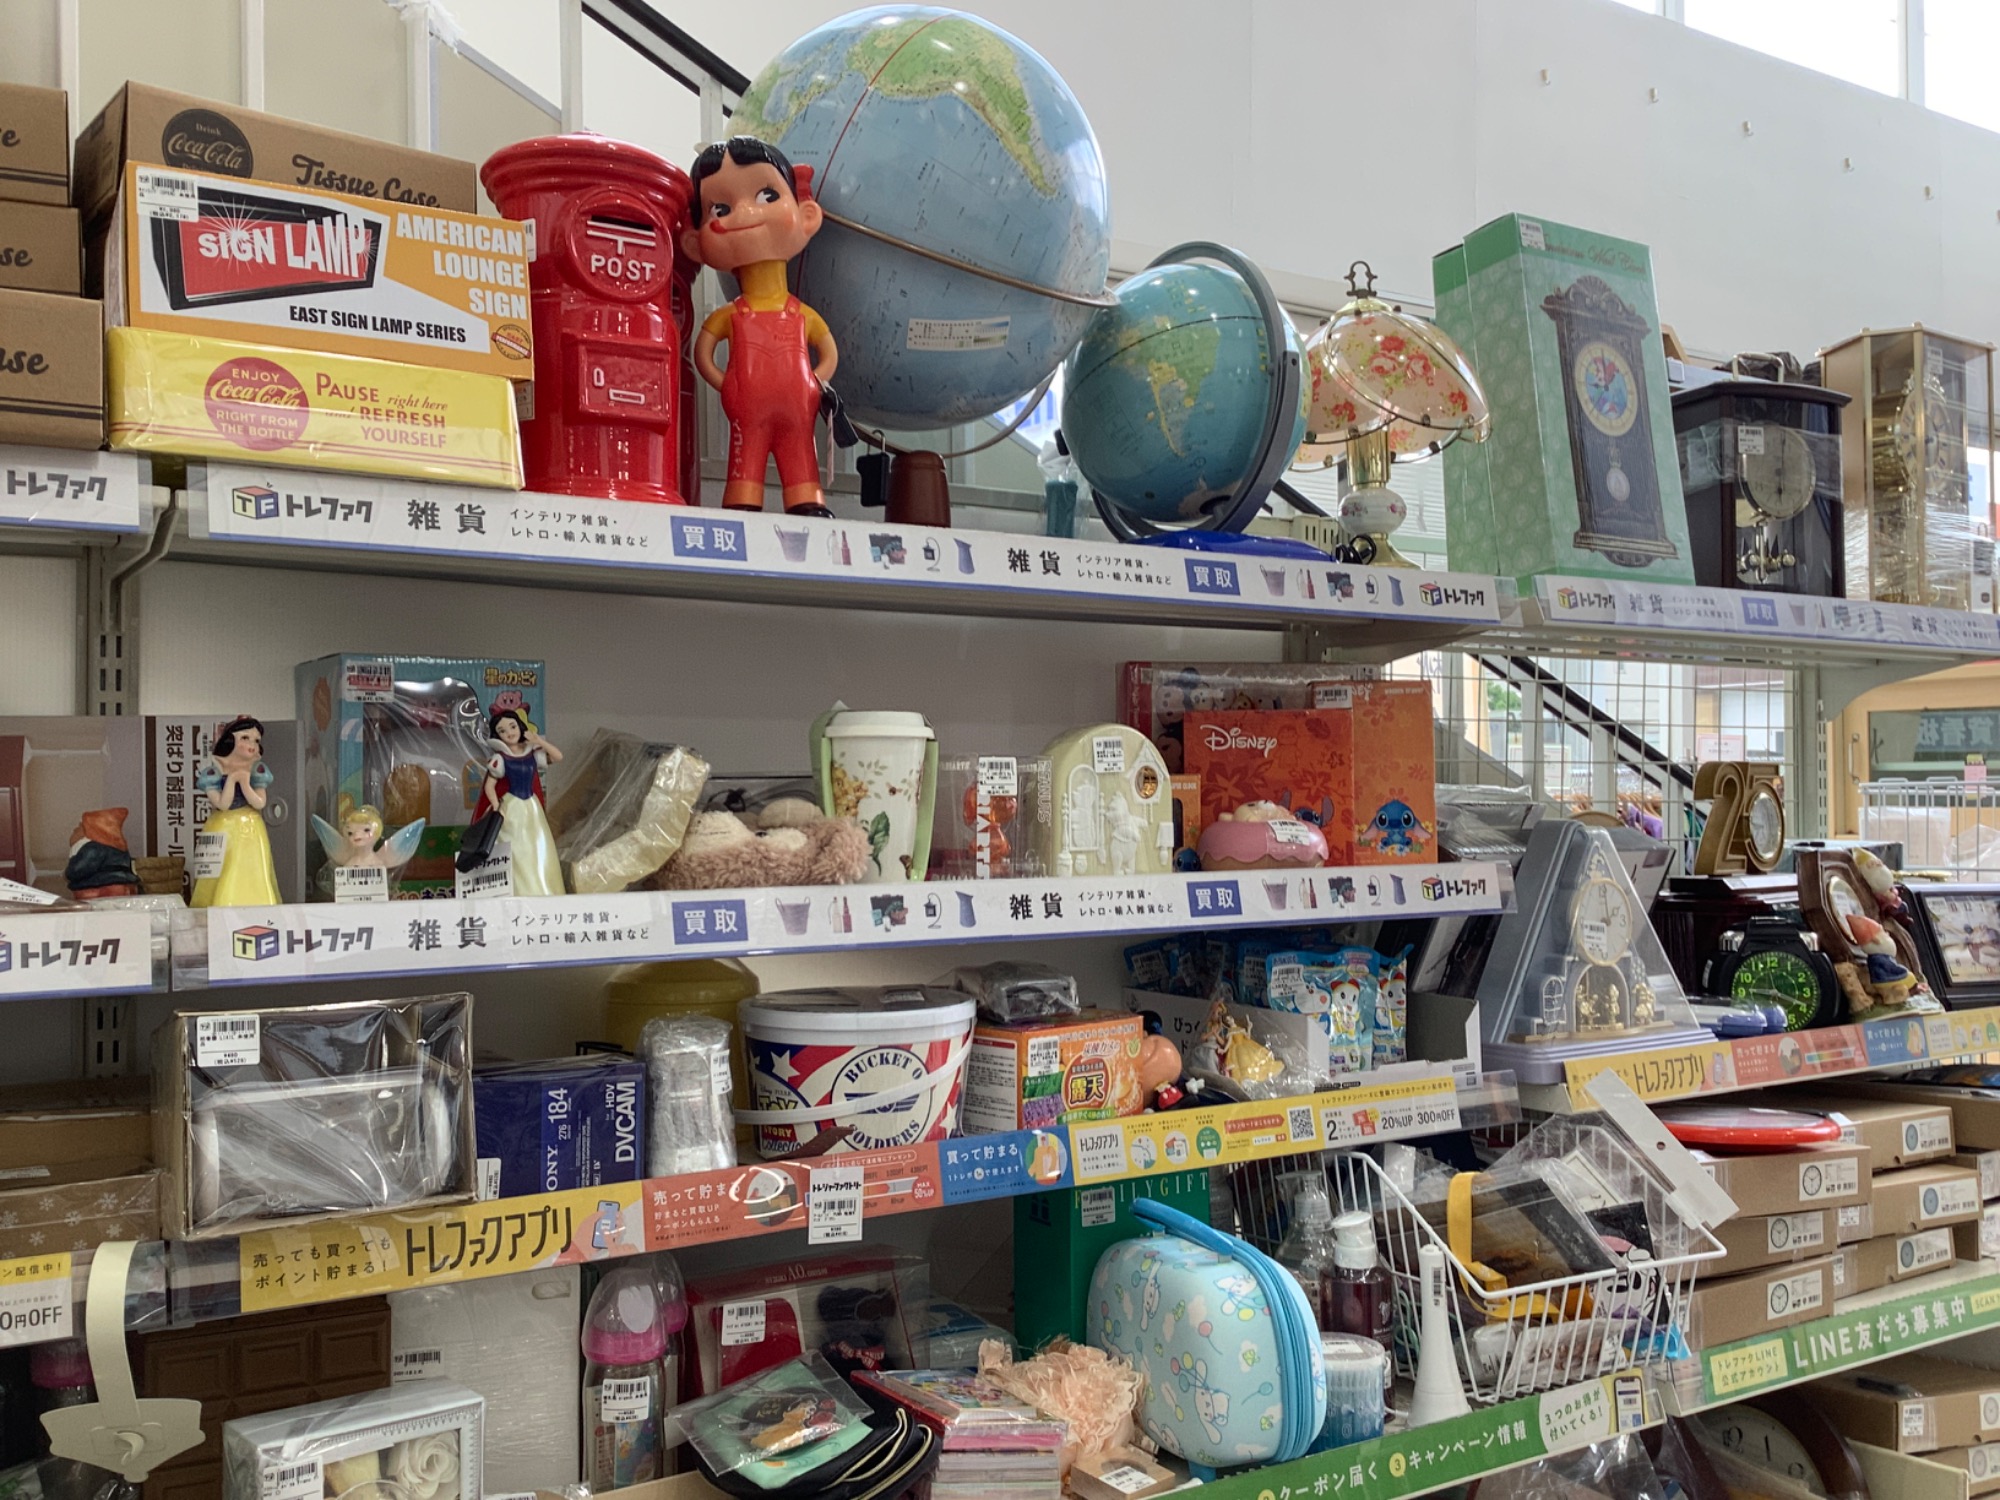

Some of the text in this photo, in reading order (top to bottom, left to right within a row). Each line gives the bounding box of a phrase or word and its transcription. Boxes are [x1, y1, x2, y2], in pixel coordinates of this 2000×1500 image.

[291, 154, 441, 207] Tissue Case
[197, 212, 366, 278] SIGN LAMP
[396, 212, 524, 257] AMERICAN
[433, 250, 526, 289] LOUNGE
[590, 254, 656, 281] POST
[468, 287, 528, 321] SIGN
[289, 304, 467, 344] EAST SIGN LAMP SERIES
[231, 367, 281, 384] ENJOY
[387, 394, 420, 409] right
[422, 395, 448, 412] here
[215, 409, 299, 429] RIGHT FROM
[359, 406, 446, 429] REFRESH
[220, 422, 296, 441] THE BOTTLE
[360, 425, 447, 449] YOURSELF
[7, 469, 107, 502] トレファク
[285, 494, 487, 535] トレファク 雑貨
[510, 525, 650, 549] レトロ・輸入雑貨など
[682, 522, 738, 553] 買取
[1006, 547, 1063, 577] 雑貨
[1076, 568, 1173, 587] レトロ・輸入雑貨など
[1193, 563, 1234, 590] 買取
[1443, 586, 1485, 608] トレファク
[1629, 592, 1665, 614] 雑貨
[1746, 602, 1775, 622] 買取
[1195, 887, 1235, 912] 買取
[1445, 878, 1487, 897] トレファク
[1008, 891, 1064, 920] 雑貨
[1078, 901, 1175, 918] レトロ・輸入雑貨など
[684, 906, 738, 936] 買取
[286, 918, 488, 954] トレファク 雑貨
[511, 927, 650, 947] レトロ・輸入雑貨など
[20, 938, 121, 969] トレファク
[1767, 957, 1778, 968] 12
[1740, 972, 1752, 984] 10
[1798, 972, 1806, 983] 2
[1737, 987, 1746, 998] 9
[1802, 986, 1811, 998] 3
[1788, 1012, 1796, 1024] 5
[844, 1051, 913, 1084] BUCKET
[1633, 1053, 1706, 1095] トレファクアプリ
[605, 1084, 615, 1108] HDV
[1070, 1074, 1106, 1104] 露天
[547, 1088, 568, 1124] 184
[1417, 1109, 1456, 1126] 300円OFF
[558, 1124, 567, 1141] 276
[615, 1081, 636, 1163] DVCAM
[761, 1123, 793, 1137] STORY
[1326, 1120, 1339, 1141] 2
[1381, 1115, 1414, 1130] 20%UP
[852, 1119, 921, 1151] OLDIERS
[1080, 1133, 1119, 1153] トレファクアプリ
[946, 1143, 1018, 1166] 買って貯まる
[546, 1145, 559, 1191] ONY
[653, 1181, 741, 1207] 売って貯まる
[811, 1181, 862, 1193] トレジャーファクトリー
[913, 1187, 936, 1200] 50%UP
[916, 1180, 931, 1189] MAX
[654, 1204, 720, 1220] 貯まると買取UP
[654, 1215, 721, 1233] クーポンもらえる
[252, 1237, 392, 1269] 売っても買っても
[405, 1205, 573, 1277] トレファクアプリ
[254, 1260, 389, 1290] ポイント貯まる!
[0, 1305, 63, 1332] 0円OFF
[1792, 1295, 1968, 1369] LINE友だち募集中
[1717, 1346, 1778, 1372] トレファクLINE
[1721, 1362, 1781, 1388] 公式アカウント
[1393, 1419, 1528, 1472] 3 キャンペーン情報
[1278, 1460, 1378, 1500] クーポン届く
